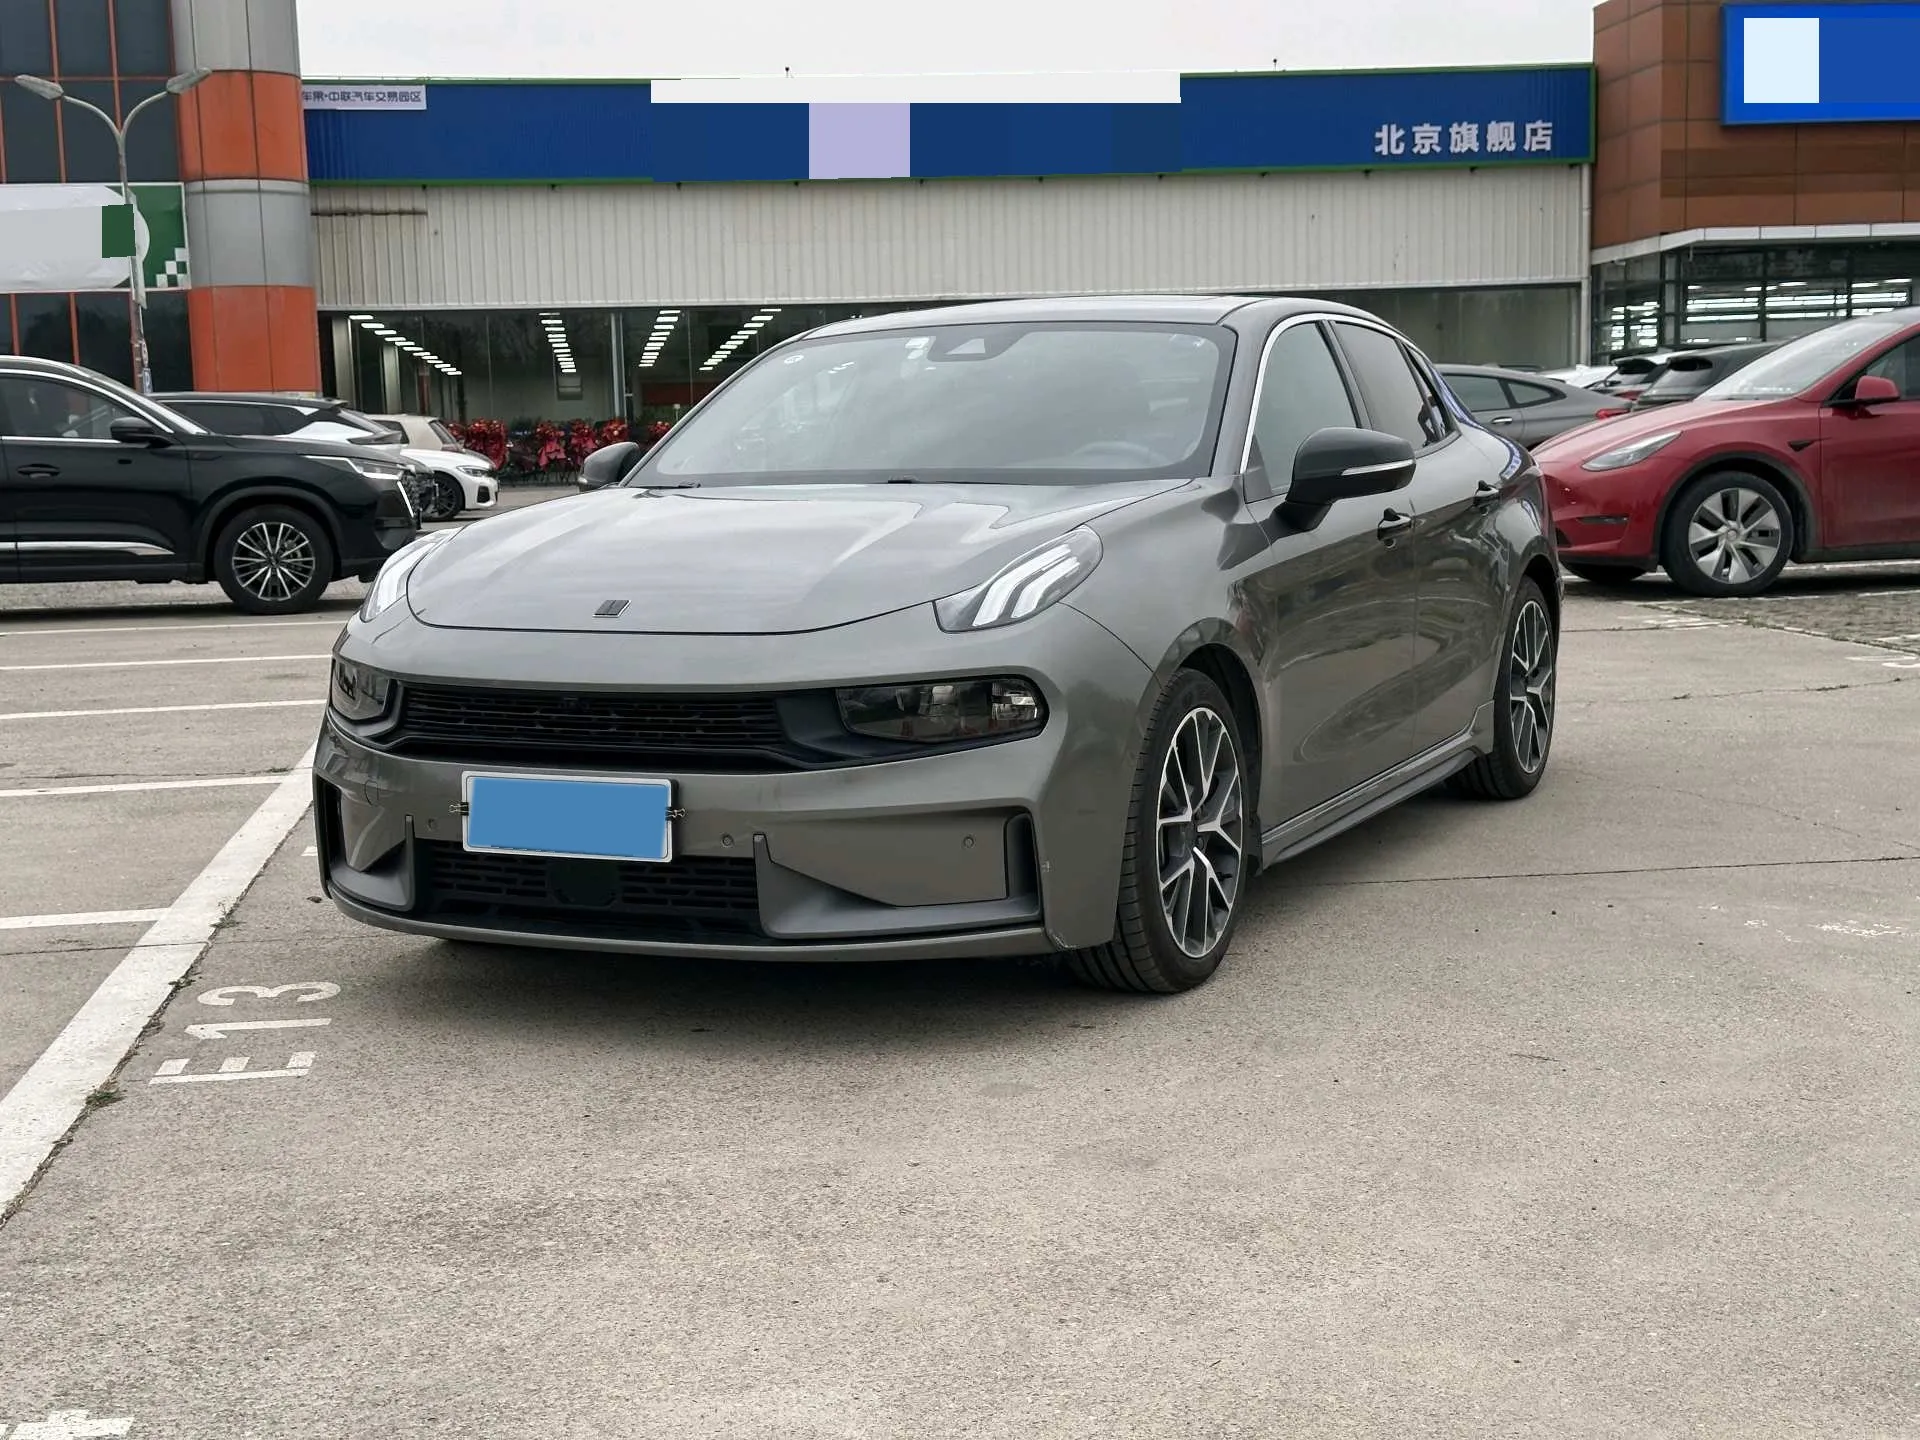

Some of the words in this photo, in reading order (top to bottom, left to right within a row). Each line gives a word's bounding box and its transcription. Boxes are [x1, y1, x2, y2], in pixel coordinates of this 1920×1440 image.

[1374, 120, 1553, 155] 北京旗舰店
[149, 981, 342, 1085] E13
